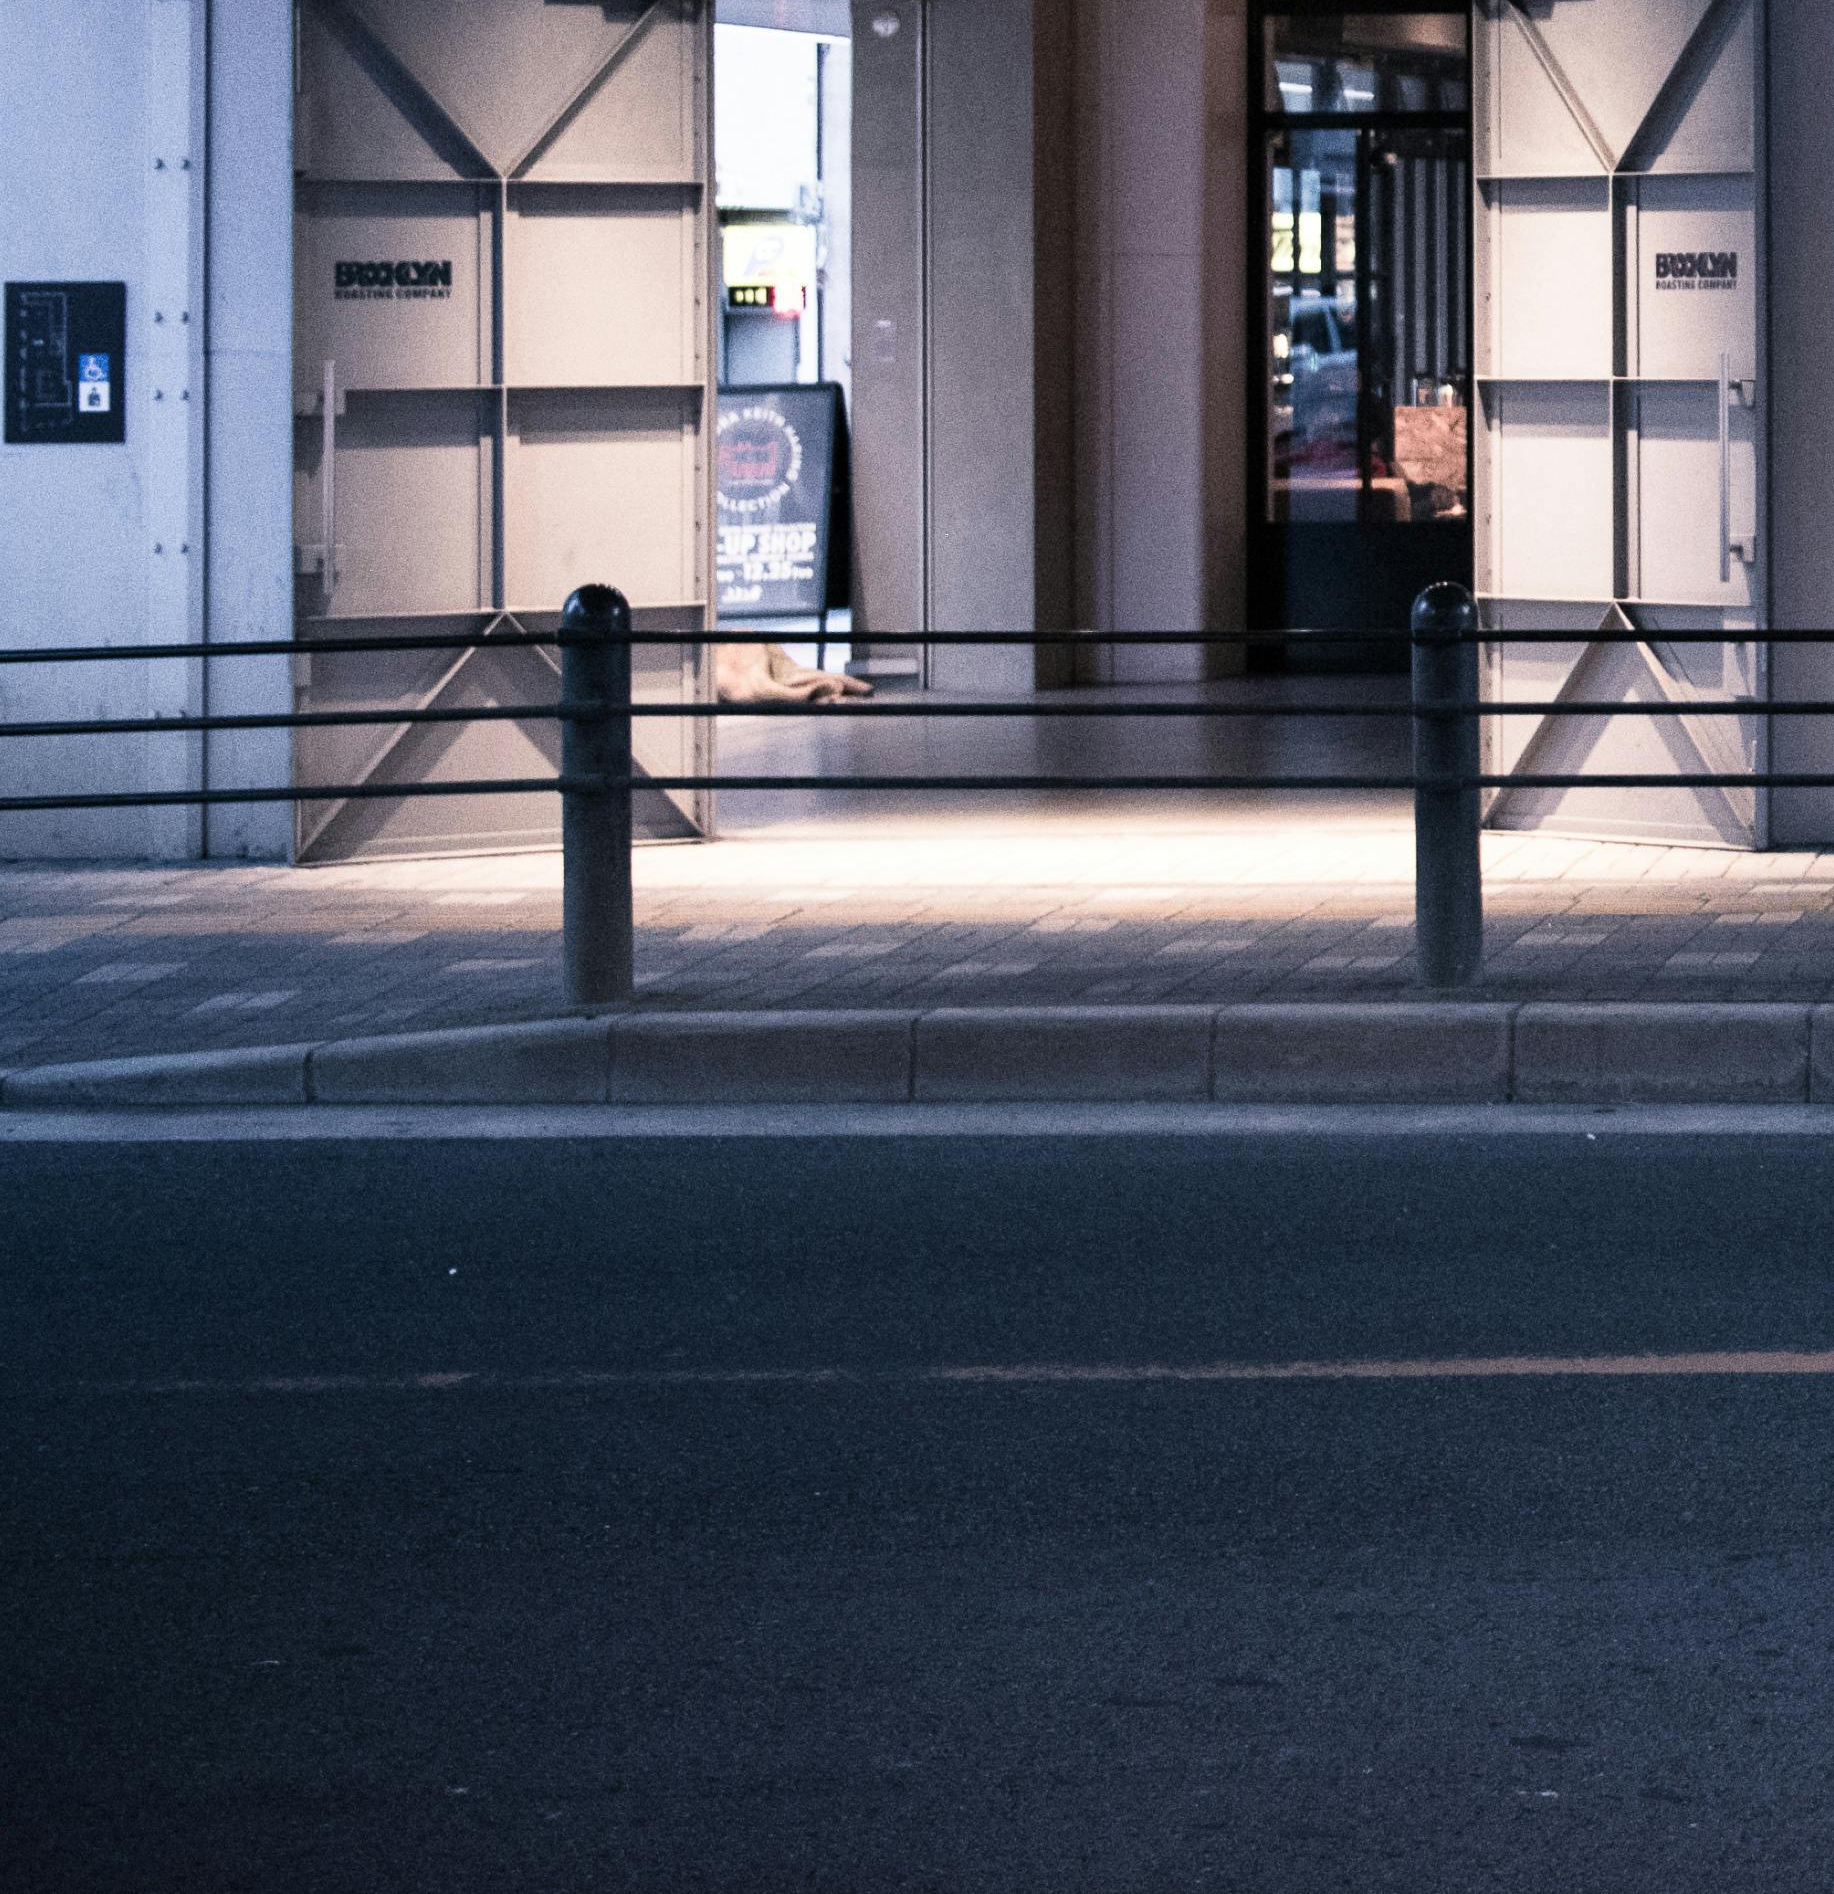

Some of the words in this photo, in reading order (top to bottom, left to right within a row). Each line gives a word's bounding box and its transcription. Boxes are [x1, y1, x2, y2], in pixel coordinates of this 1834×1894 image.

[1656, 280, 1695, 290] ROASTING
[1698, 279, 1737, 290] COMPANY
[717, 482, 790, 512] OLLECTION
[717, 532, 756, 556] -UP
[758, 530, 817, 555] SHOP
